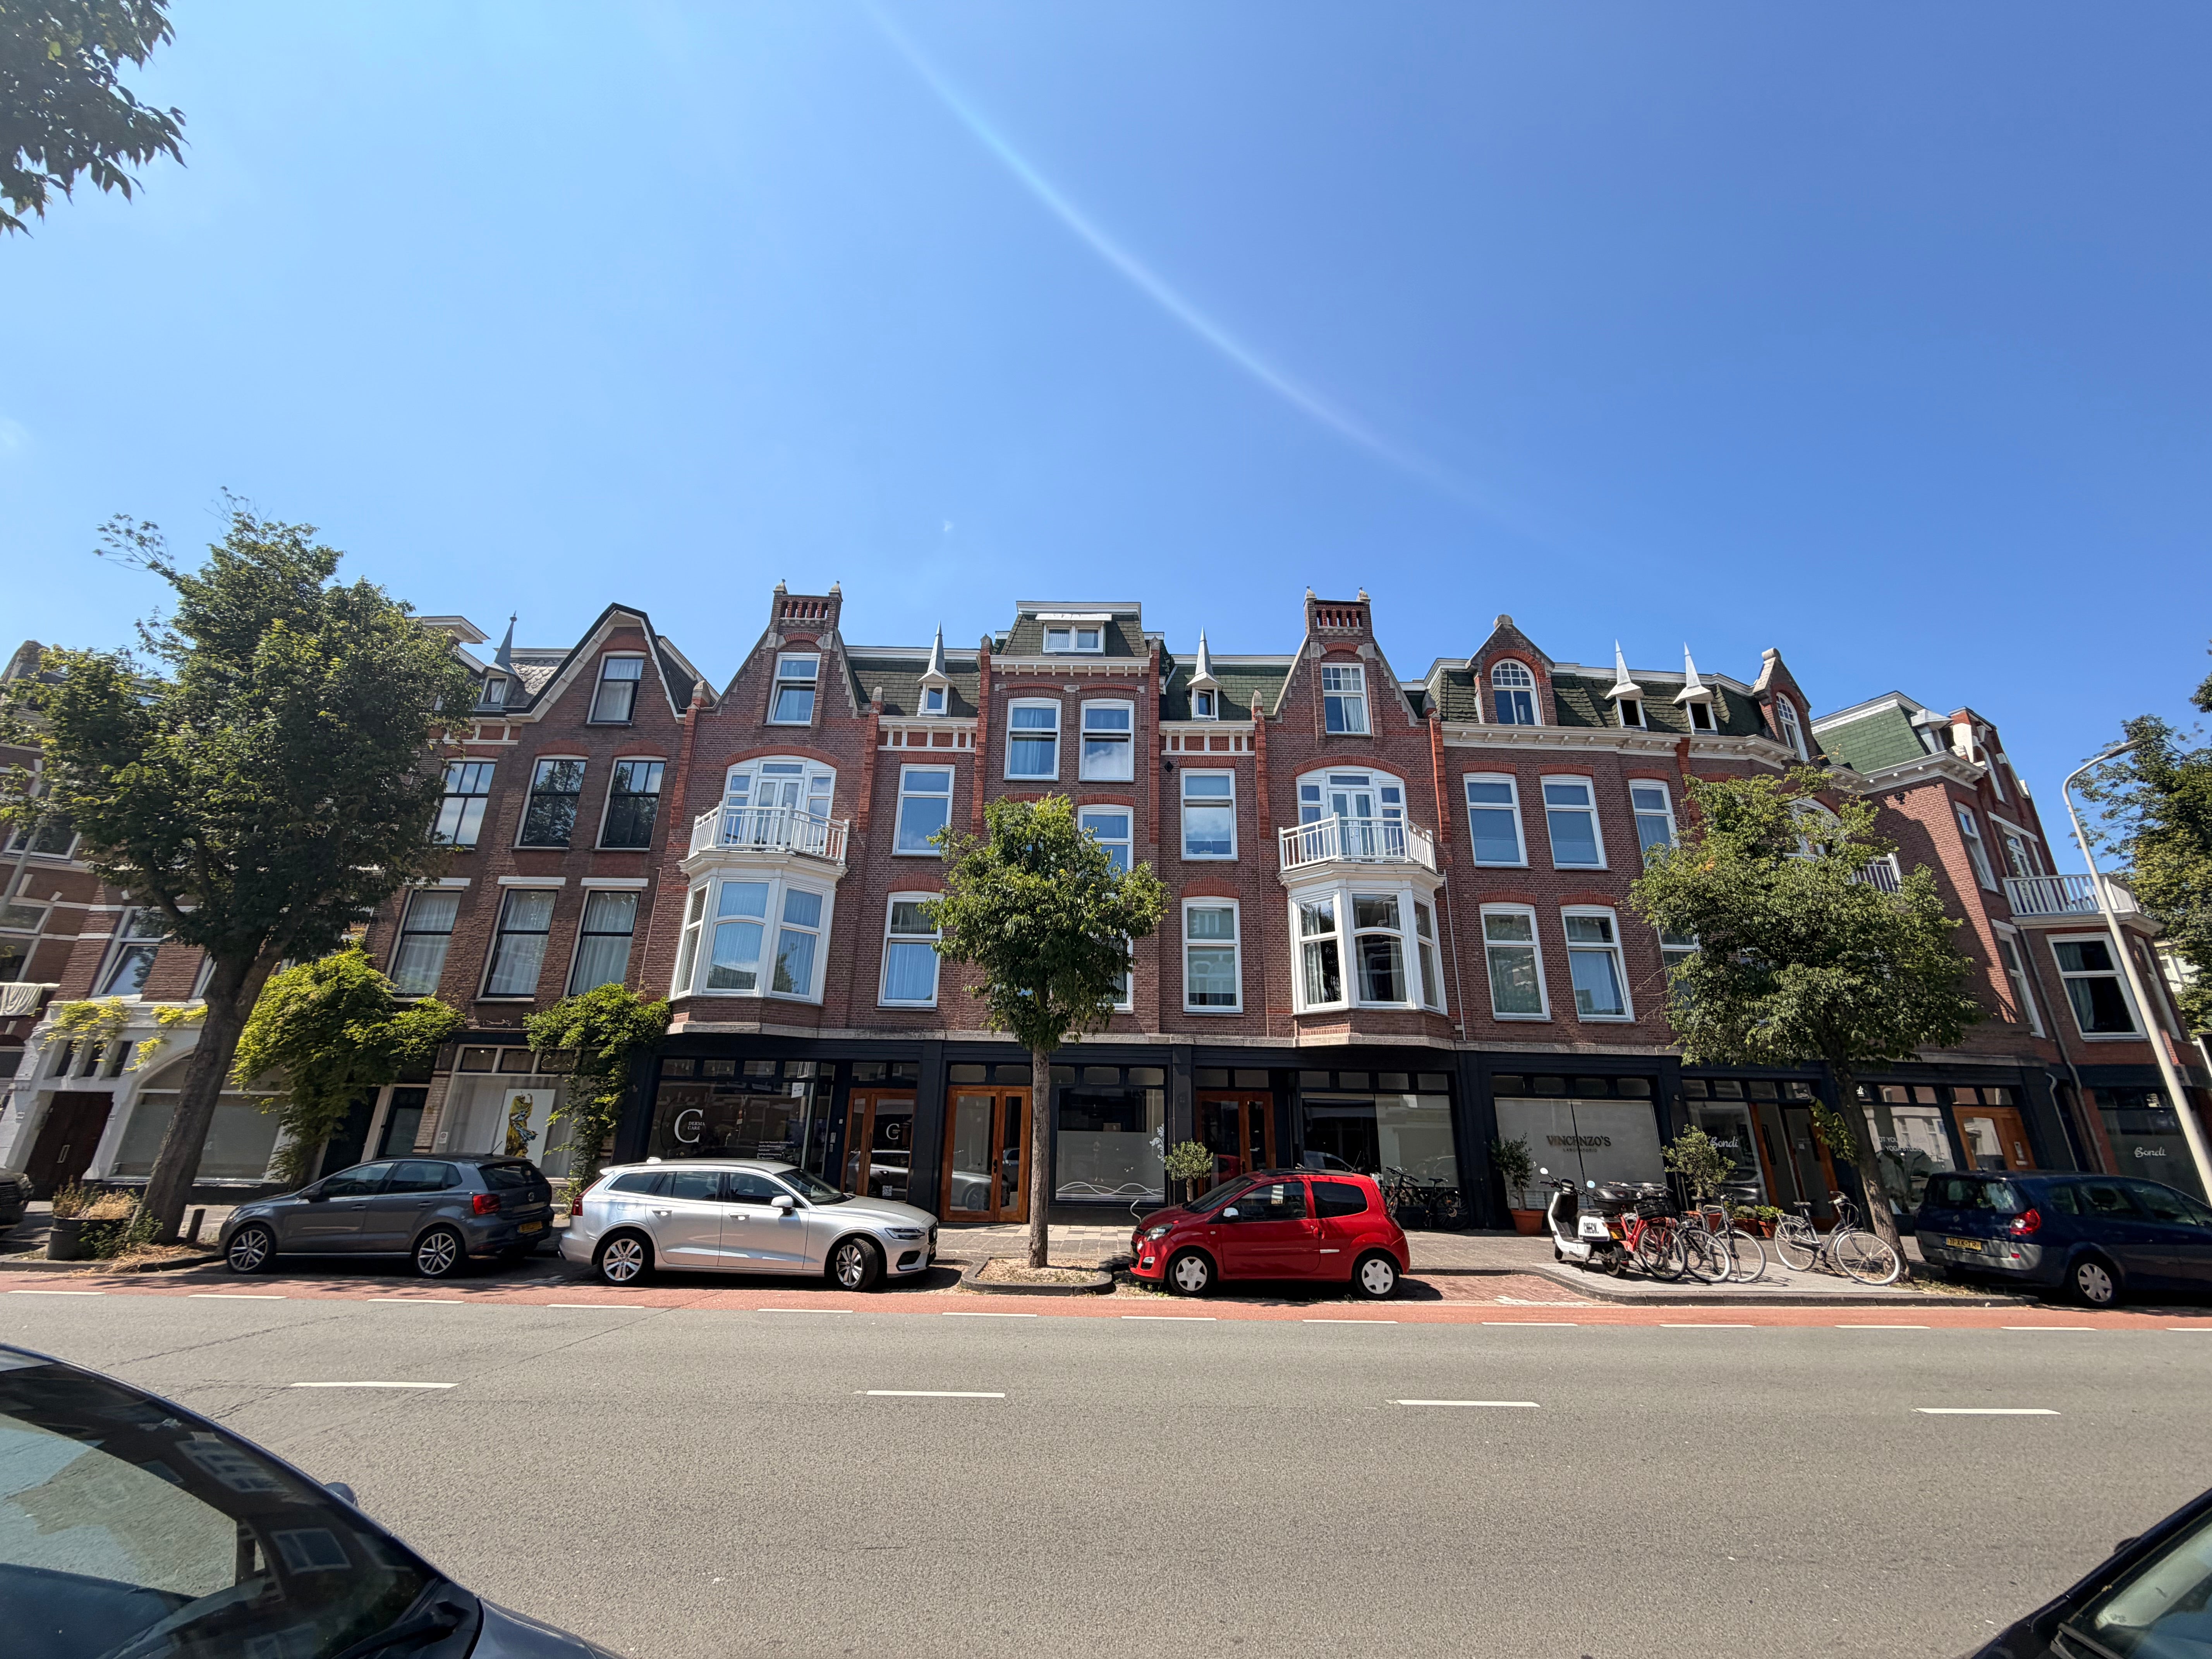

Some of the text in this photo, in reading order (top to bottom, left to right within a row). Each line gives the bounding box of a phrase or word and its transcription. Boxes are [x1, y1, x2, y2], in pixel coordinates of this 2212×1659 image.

[674, 1109, 703, 1143] C
[1546, 1135, 1611, 1147] VINCENZO'S
[1709, 1135, 1738, 1149] Bondi
[2134, 1147, 2167, 1158] Bondi
